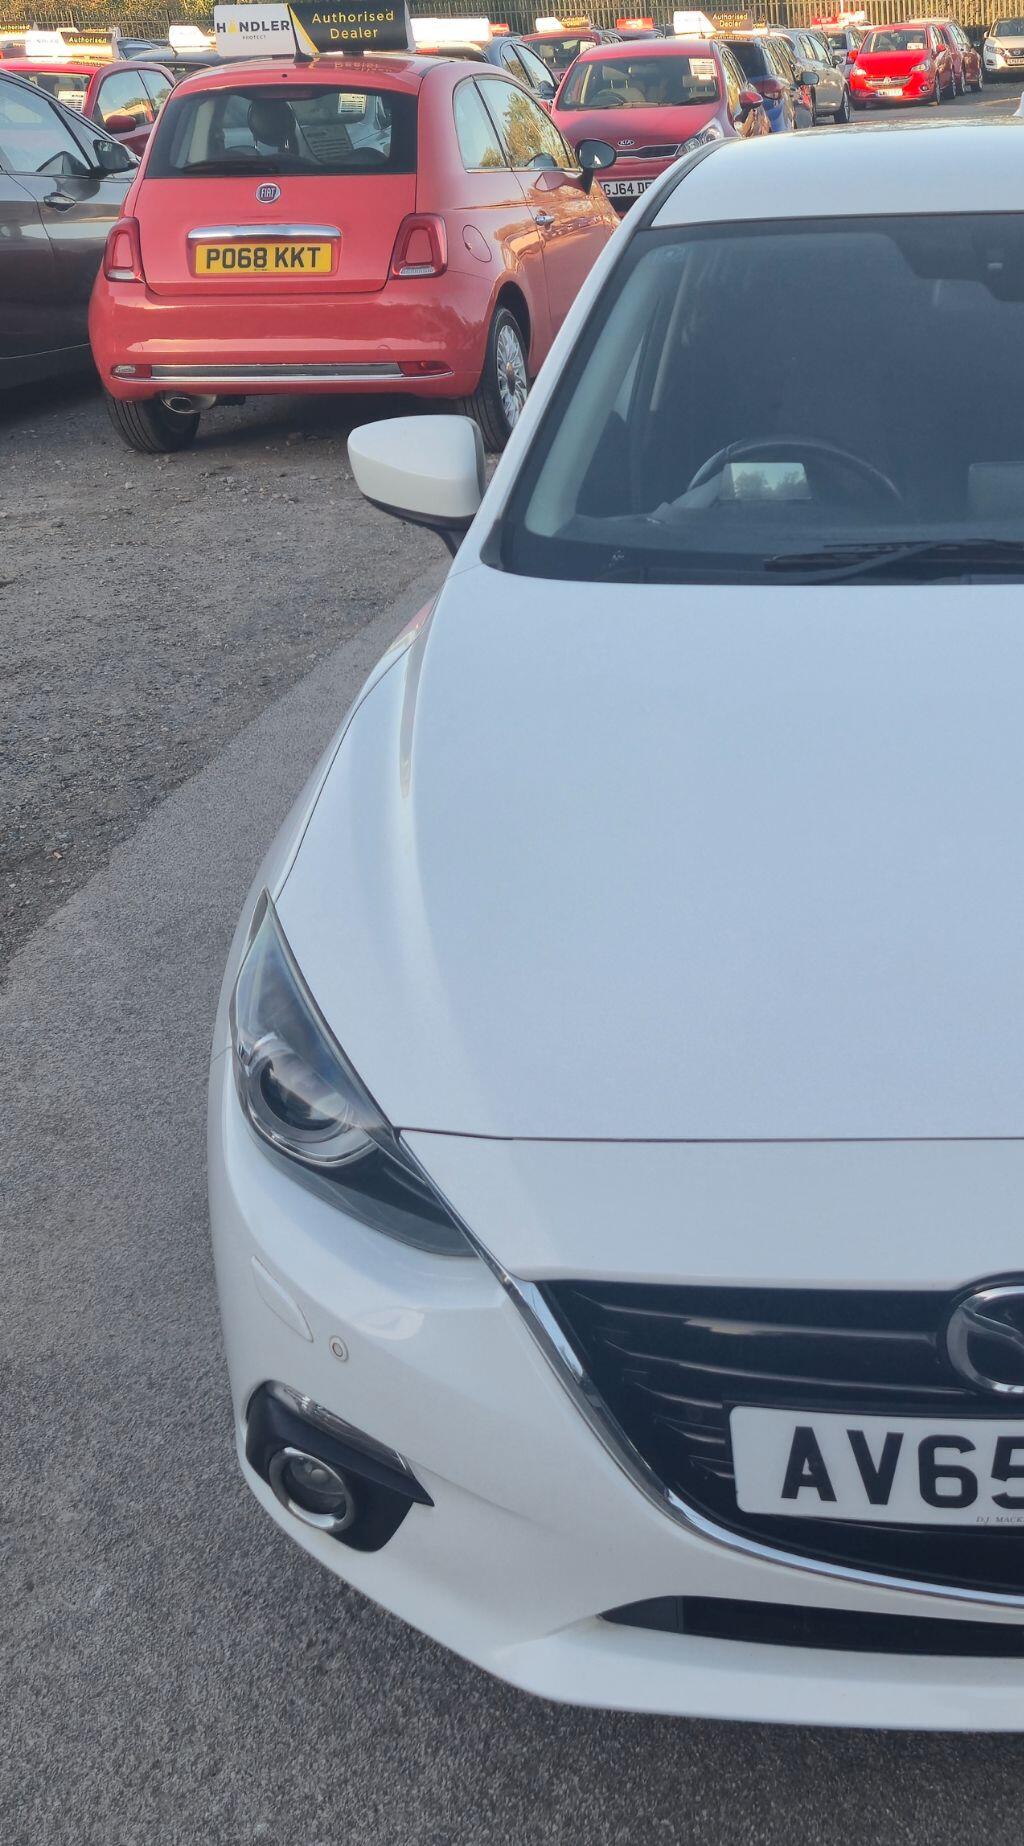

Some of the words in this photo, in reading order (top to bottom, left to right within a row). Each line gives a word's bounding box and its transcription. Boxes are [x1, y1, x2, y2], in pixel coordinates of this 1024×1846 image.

[312, 8, 394, 24] Authorised
[68, 36, 108, 44] Authorised
[330, 27, 379, 40] Dealer
[260, 187, 276, 198] FIAT
[602, 181, 634, 196] GJ64
[274, 246, 321, 269] KKT
